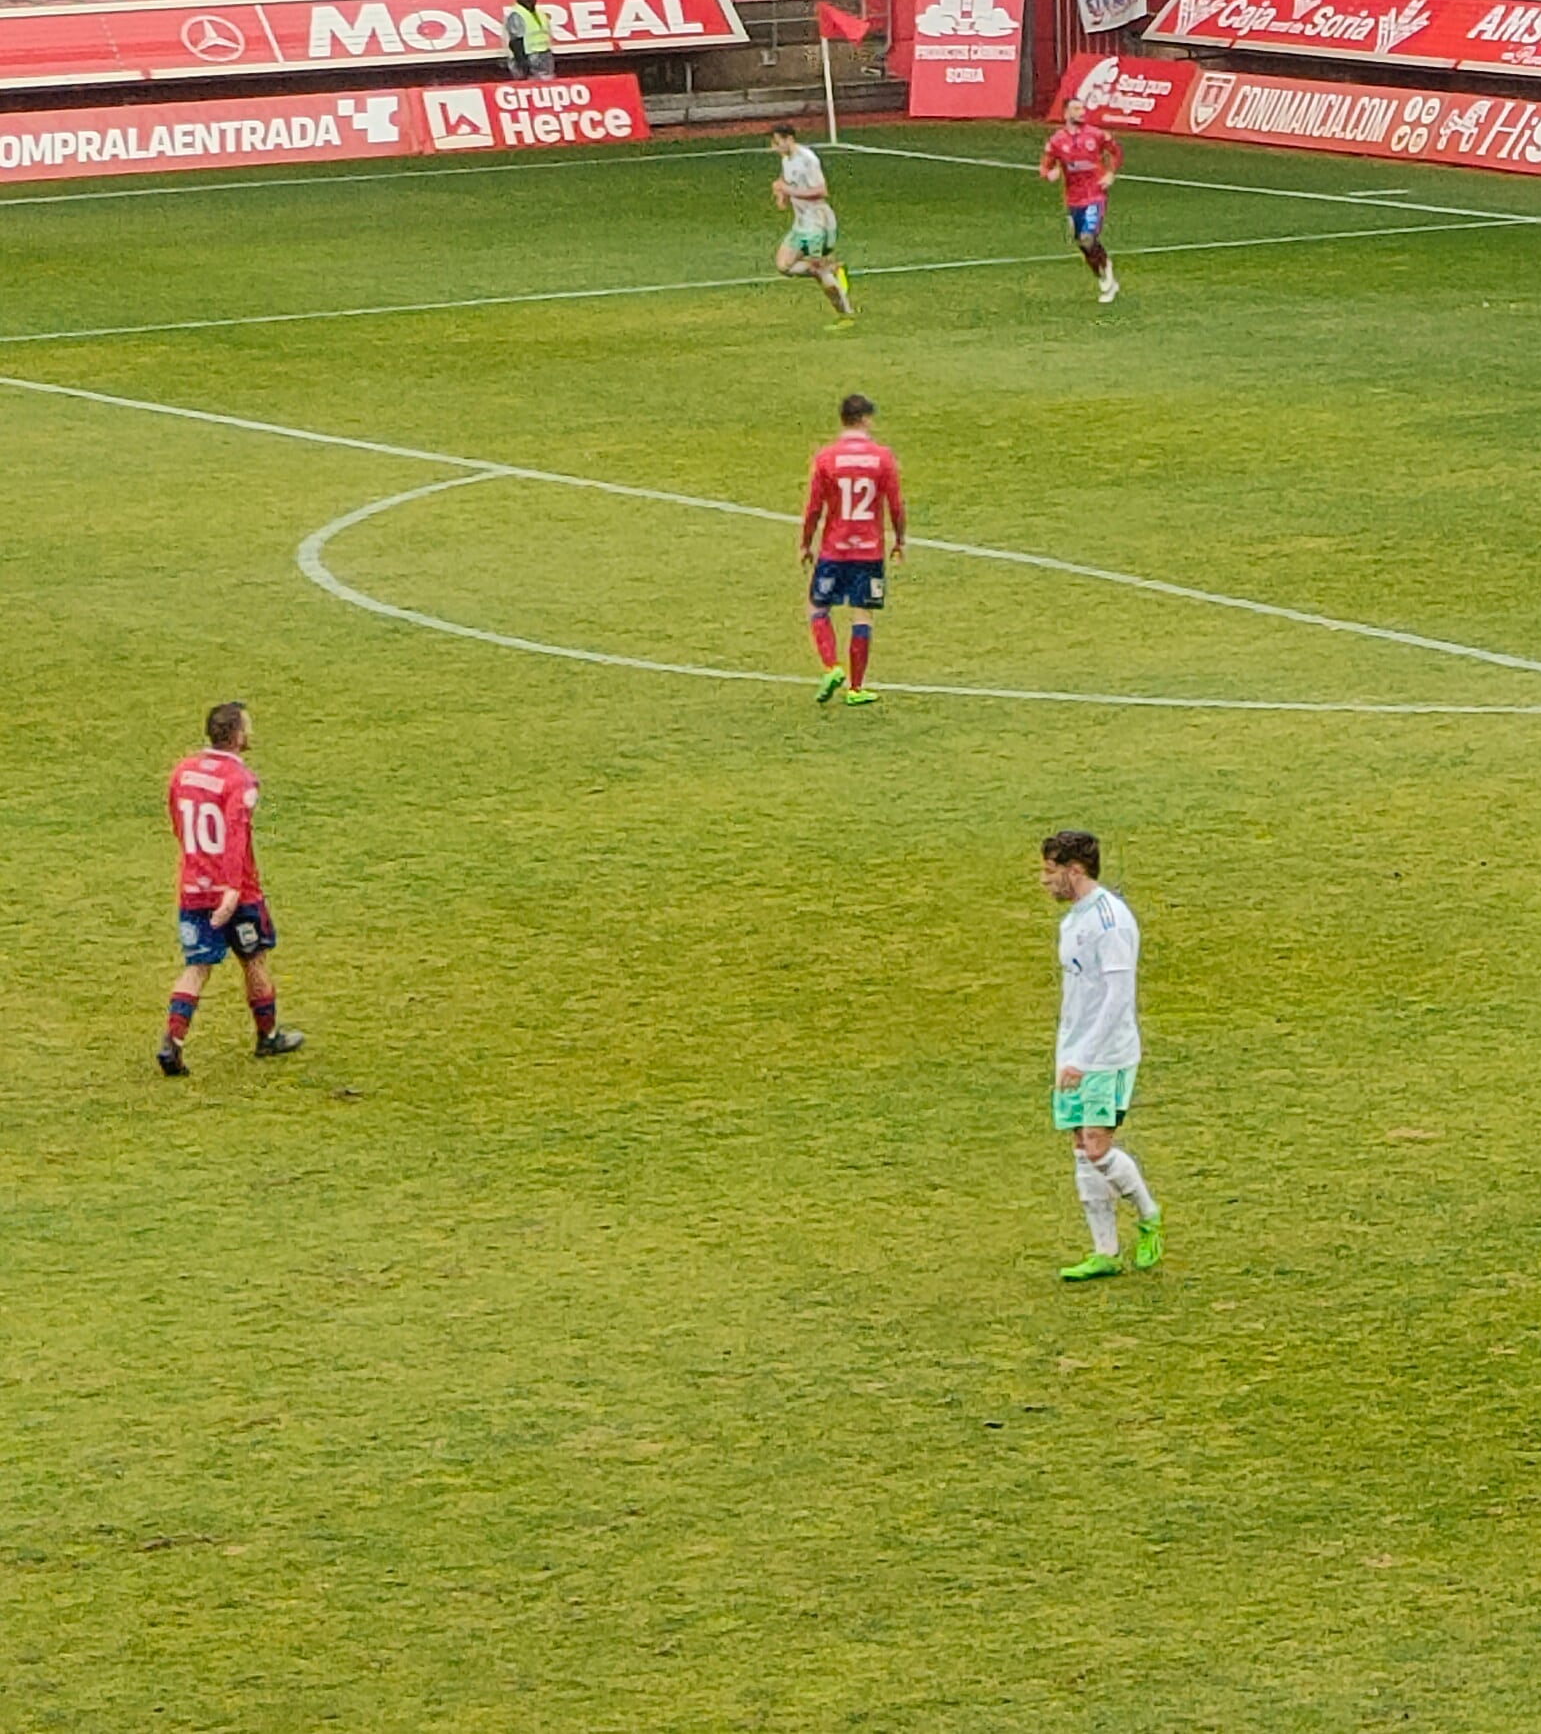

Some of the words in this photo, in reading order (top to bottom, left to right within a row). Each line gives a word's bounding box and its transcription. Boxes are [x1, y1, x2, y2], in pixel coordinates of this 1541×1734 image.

[1304, 6, 1376, 41] Soria
[493, 82, 592, 114] Grupo
[1225, 85, 1399, 143] CDNUMANCIA.COM
[497, 104, 632, 146] Herce
[838, 477, 876, 521] 12
[178, 798, 226, 854] 10
